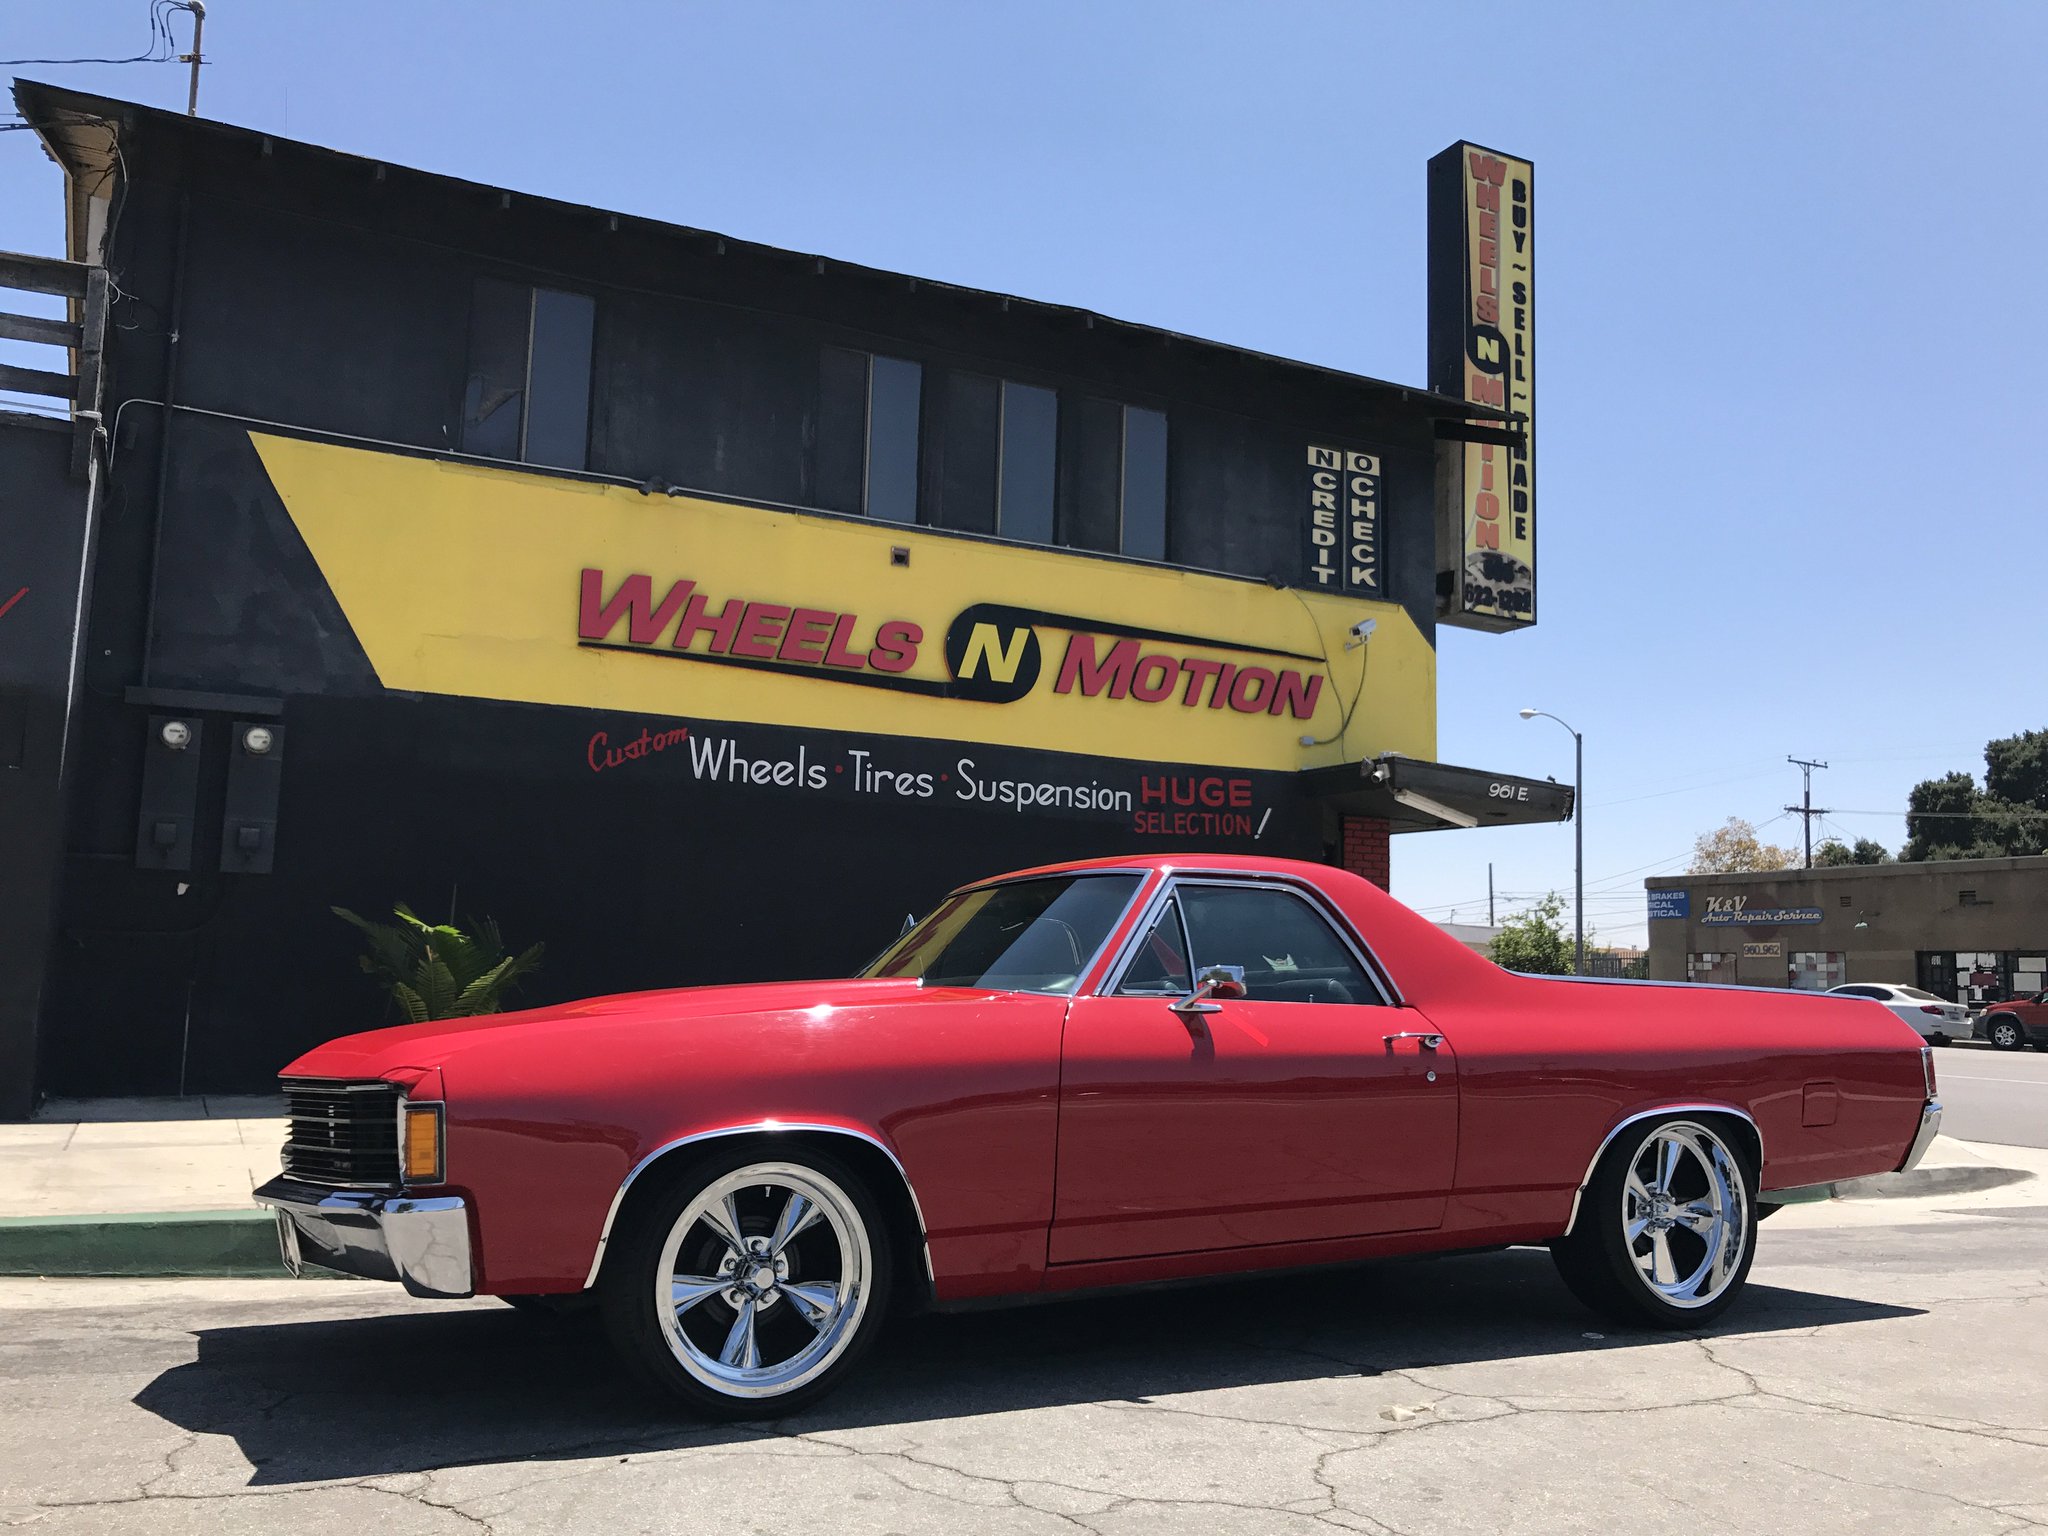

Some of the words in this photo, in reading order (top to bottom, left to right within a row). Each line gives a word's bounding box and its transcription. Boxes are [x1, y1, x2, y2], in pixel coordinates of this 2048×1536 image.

[1469, 152, 1507, 324] WHEELS
[1512, 179, 1527, 253] BUY
[1476, 335, 1499, 364] N
[1512, 281, 1527, 382] SELL
[1311, 472, 1337, 585] CREDIT
[1350, 476, 1376, 587] CHECK
[577, 568, 924, 672] WHEELS
[956, 622, 1031, 683] N
[1053, 634, 1324, 720] MOTION
[588, 727, 690, 772] Custom
[689, 734, 827, 789] Wheels
[848, 749, 933, 798] Tires
[955, 758, 1132, 812] Suspension
[1140, 776, 1252, 807] HUGE
[1488, 782, 1514, 799] 961
[1701, 912, 1733, 923] Auto
[1733, 910, 1773, 923] Repair
[1706, 895, 1747, 912] K&V
